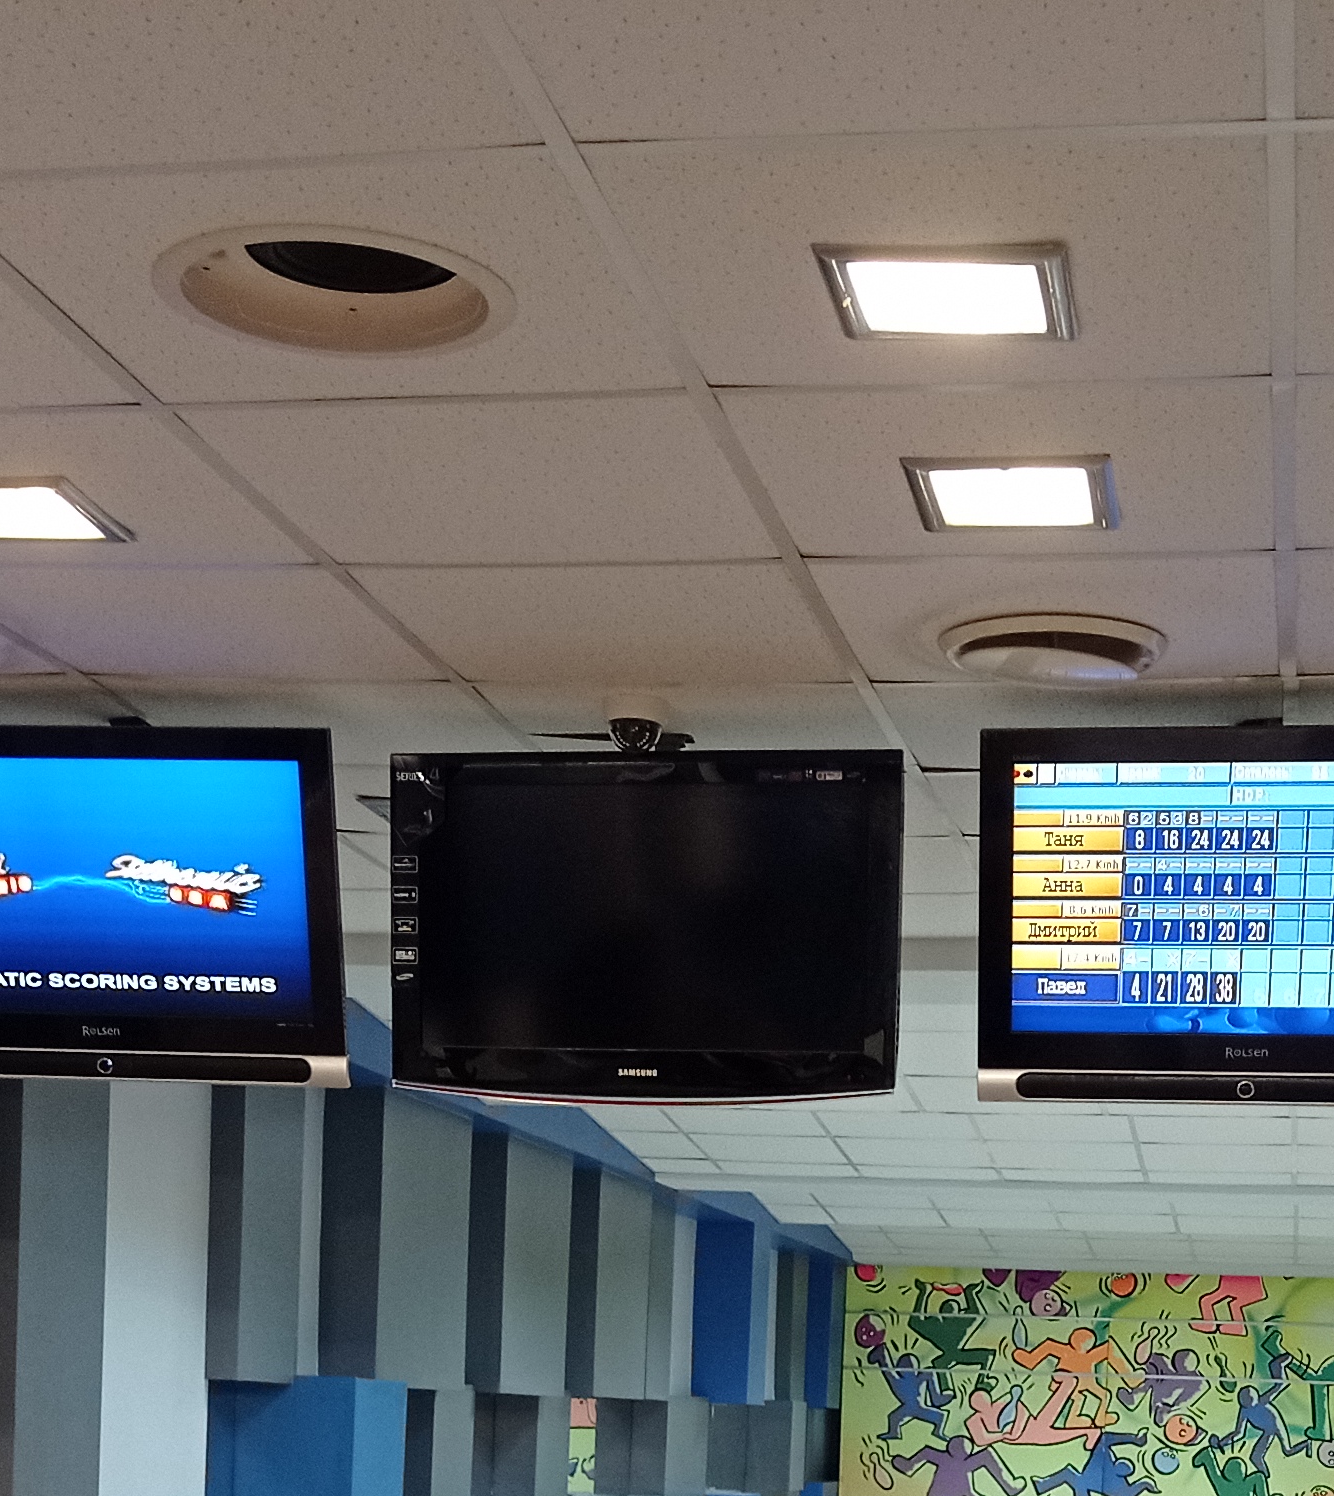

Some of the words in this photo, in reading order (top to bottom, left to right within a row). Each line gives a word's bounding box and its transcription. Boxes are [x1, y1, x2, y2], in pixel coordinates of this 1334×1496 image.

[1044, 832, 1084, 847] Таня
[1162, 831, 1179, 849] 16
[1191, 831, 1210, 849] 24
[1221, 831, 1240, 849] 24
[1251, 831, 1270, 849] 24
[1042, 878, 1084, 893] Анна
[1134, 877, 1143, 895] 0
[1163, 877, 1173, 895] 4
[1193, 877, 1203, 895] 4
[1223, 877, 1233, 895] 4
[1253, 877, 1263, 895] 4
[1028, 921, 1098, 942] Дмитрий
[1133, 922, 1142, 940] 7
[1162, 922, 1172, 940] 7
[1189, 922, 1206, 941] 13
[1217, 922, 1236, 941] 20
[1248, 922, 1266, 941] 20
[48, 972, 158, 991] SCORING
[163, 975, 277, 993] SYSTEMS
[1037, 977, 1087, 996] Павел
[1130, 973, 1141, 1002] 4
[1156, 973, 1173, 1002] 21
[1186, 974, 1204, 1003] 28
[1215, 974, 1234, 1003] 38
[618, 1068, 657, 1077] SAMSUNG
